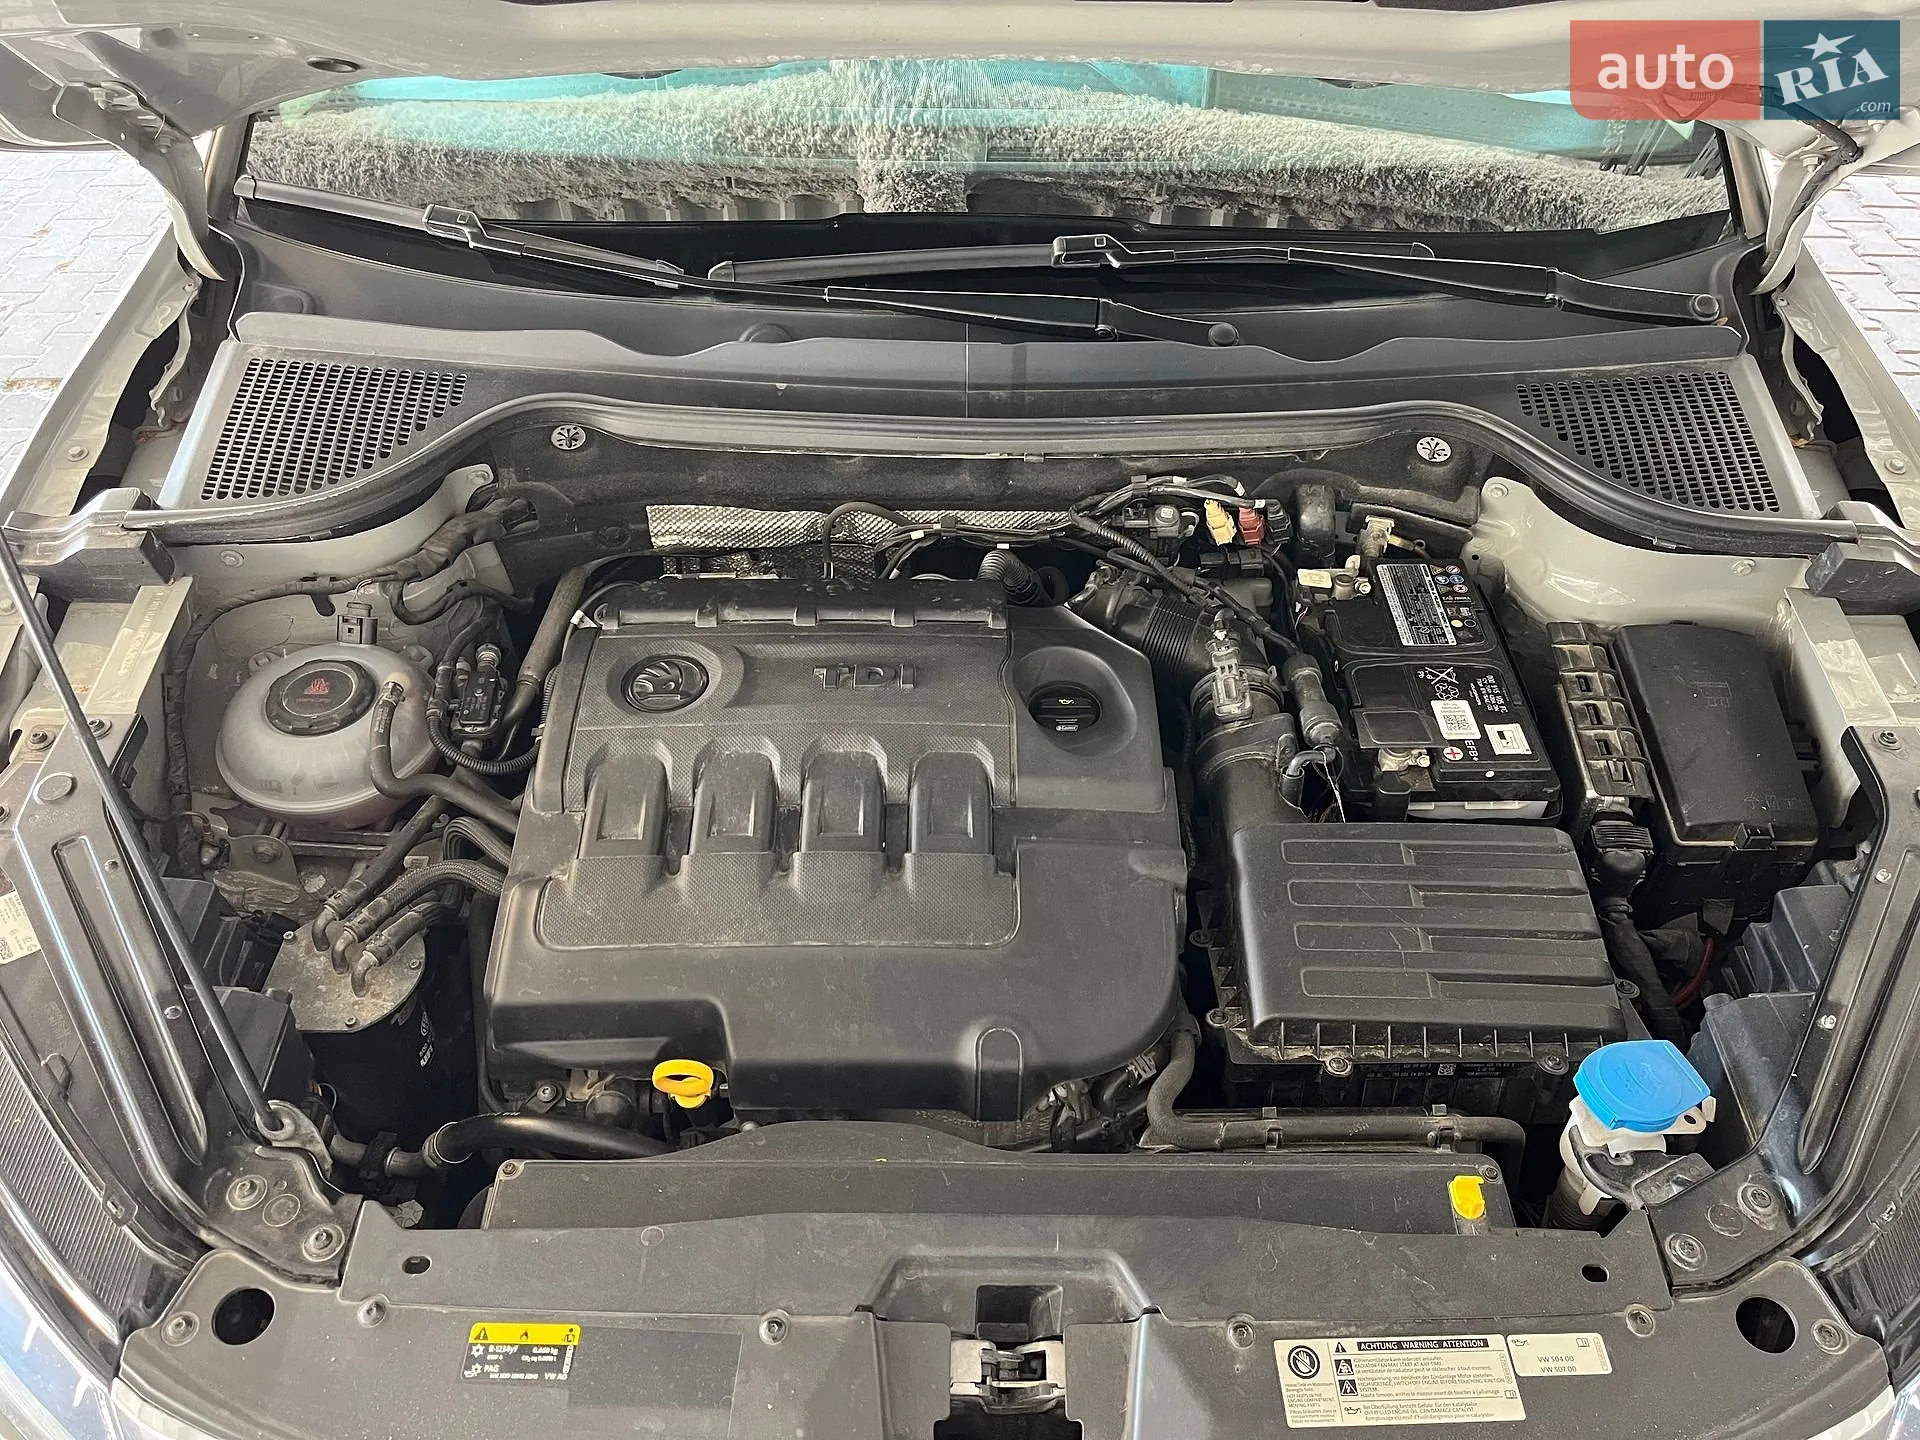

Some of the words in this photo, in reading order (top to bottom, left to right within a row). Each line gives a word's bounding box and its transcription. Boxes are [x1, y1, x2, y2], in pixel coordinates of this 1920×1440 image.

[813, 664, 916, 690] TDI
[1360, 1341, 1398, 1350] ACHTUNG
[1401, 1340, 1439, 1349] WARNING
[1442, 1340, 1484, 1348] ATTENTION
[484, 1365, 499, 1373] PAG
[544, 1372, 557, 1380] VW
